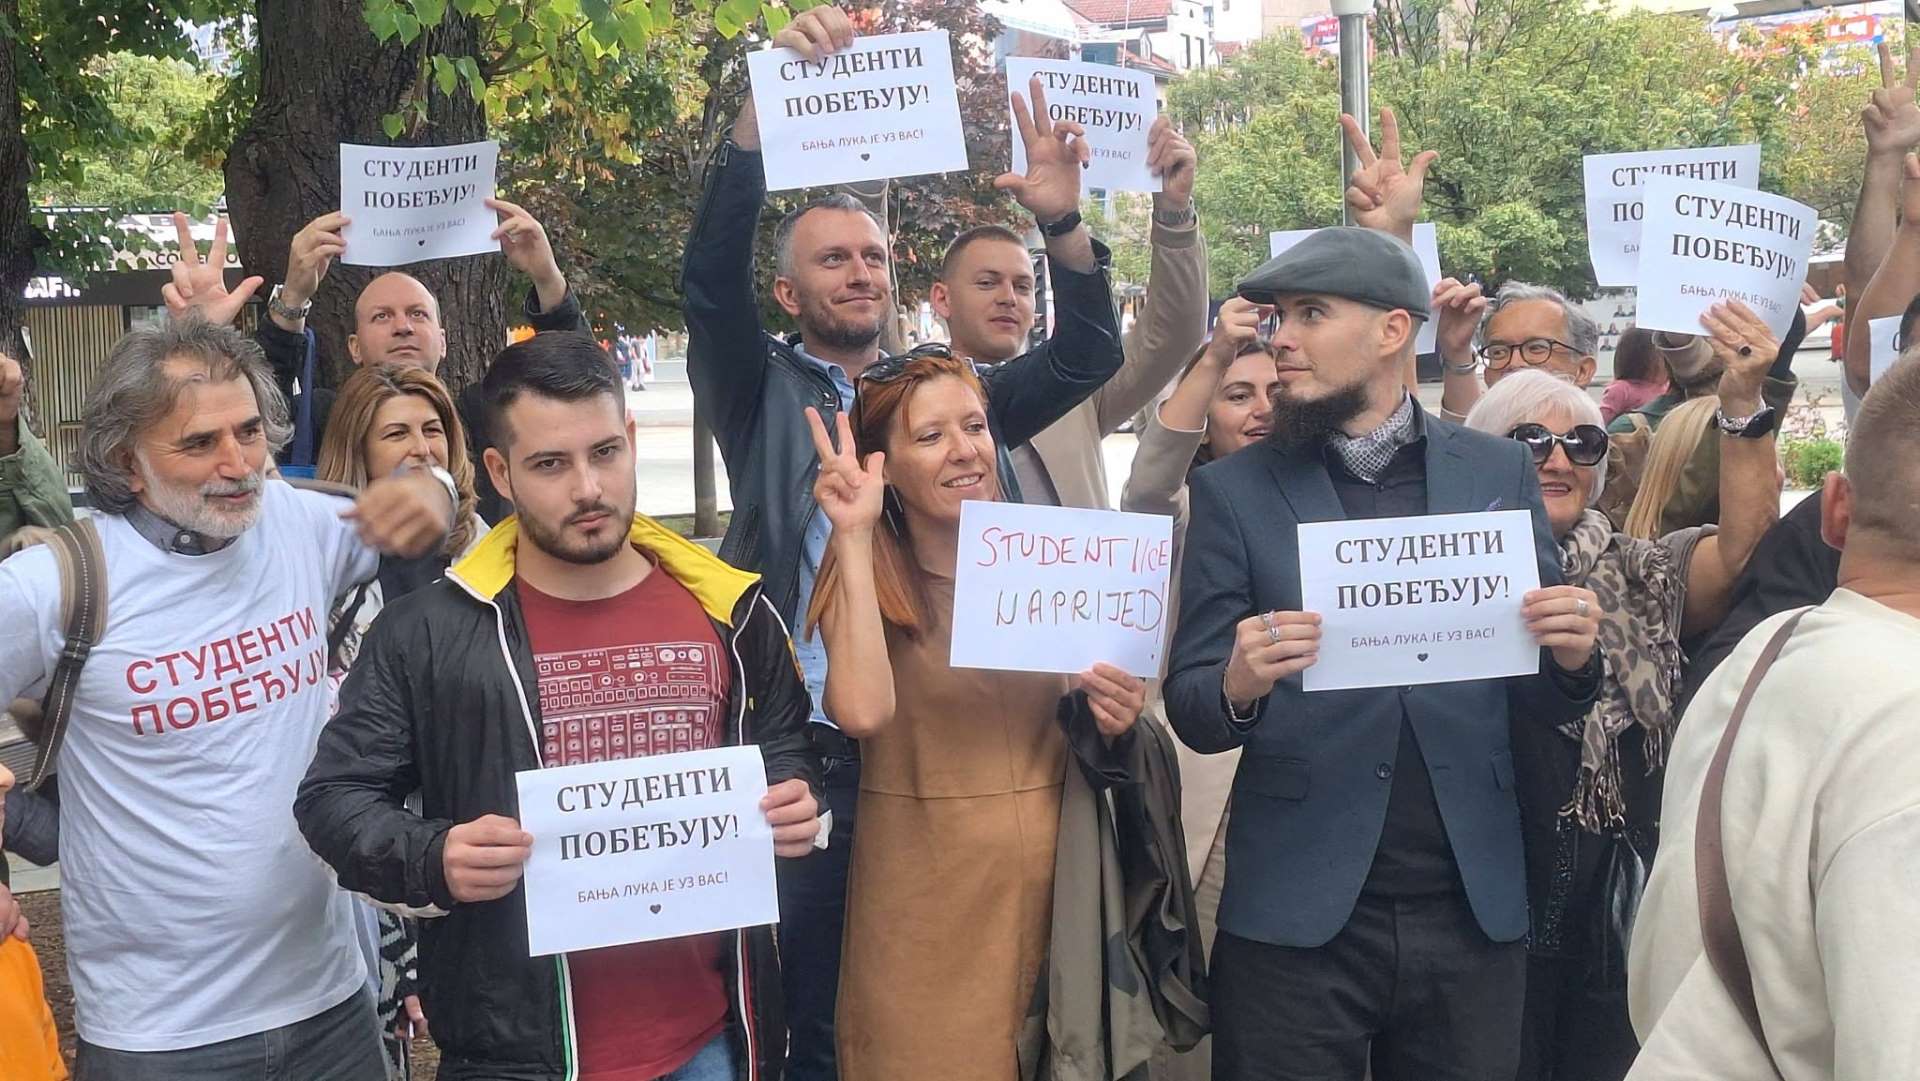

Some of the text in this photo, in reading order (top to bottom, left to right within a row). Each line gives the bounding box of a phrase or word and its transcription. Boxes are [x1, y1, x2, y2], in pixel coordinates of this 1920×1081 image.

[780, 47, 923, 81] СТУДЕНТИ
[785, 84, 930, 117] ПОБЕЂУЈУ!
[1050, 104, 1142, 132] ОБЕЂУЈУ!
[802, 129, 924, 151] БАЊА ЛУКА ЈЕ УЗ ВАС!
[364, 155, 477, 181] СТУДЕНТИ
[364, 184, 476, 208] ПОБЕЂУЈУ!
[1675, 194, 1801, 240] СТУДЕНТИ
[1672, 233, 1797, 280] ПОБЕЂУЈУ!
[1680, 284, 1715, 297] БАЊА
[1335, 529, 1504, 565] СТУДЕНТИ
[1337, 575, 1509, 609] ПОБЕЂУЈУ!
[126, 607, 318, 694] СТУДЕНТИ
[1351, 626, 1495, 648] БАЊА ЛУКА ЈЕ УЗ ВАС!
[557, 766, 732, 812] СТУДЕНТИ
[560, 814, 739, 860] ПОБЕЂУЈУ!
[578, 871, 729, 903] БАЊА ЛУКА ЈЕ УЗ ВАС!
